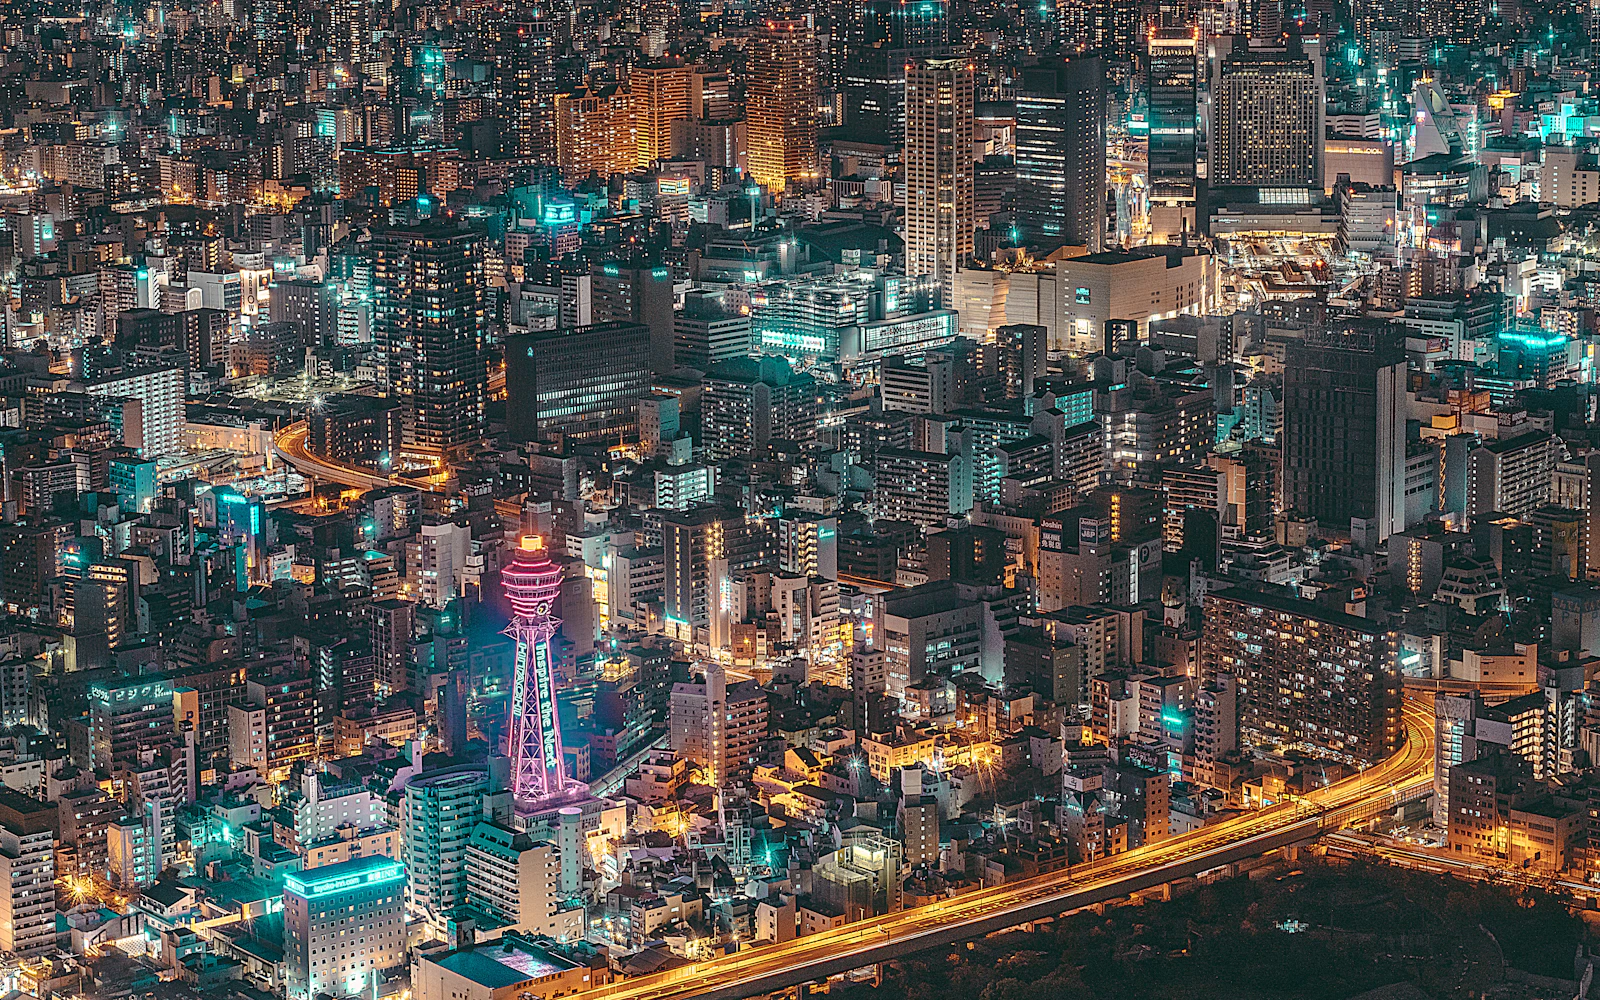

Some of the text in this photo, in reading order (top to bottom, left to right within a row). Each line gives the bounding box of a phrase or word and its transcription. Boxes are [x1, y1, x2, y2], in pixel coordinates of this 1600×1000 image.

[247, 272, 255, 312] ARROW
[1041, 519, 1062, 530] Joshin
[1081, 530, 1096, 538] J&P
[513, 641, 527, 717] HITACHI
[535, 641, 556, 769] Inspire the Next
[313, 878, 359, 893] toyoko-inn.com
